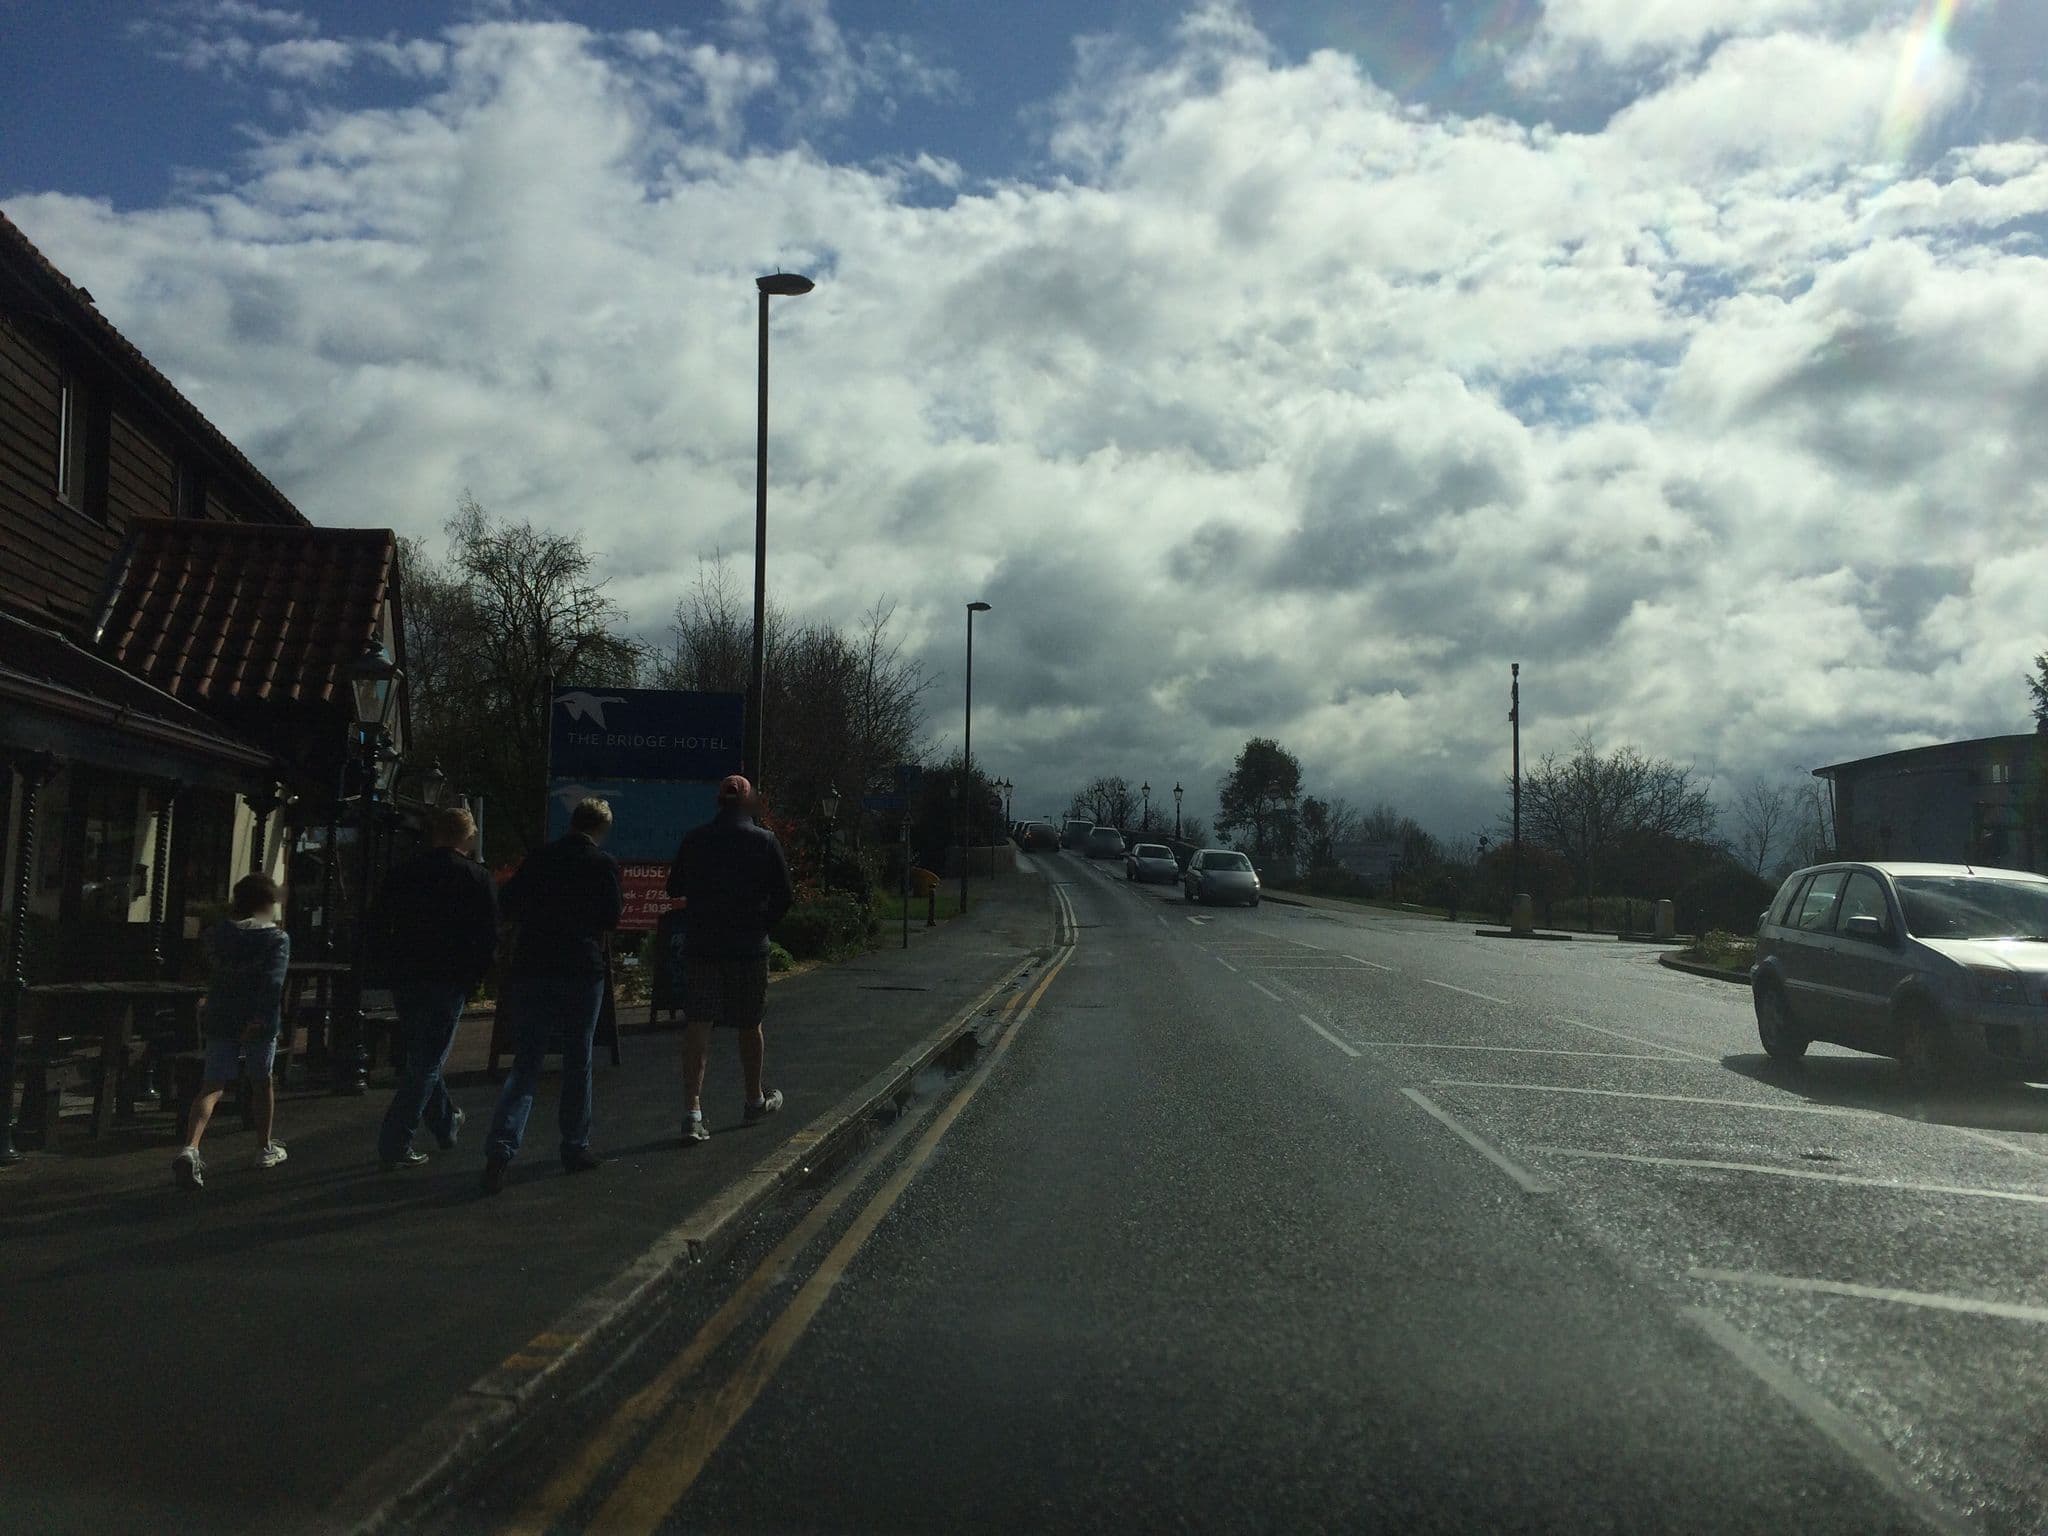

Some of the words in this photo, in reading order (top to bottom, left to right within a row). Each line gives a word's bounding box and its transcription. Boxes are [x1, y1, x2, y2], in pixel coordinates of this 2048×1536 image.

[568, 732, 600, 745] THE
[606, 734, 667, 747] BRIDGE
[673, 736, 728, 750] HOTEL
[623, 865, 665, 878] HOUSE
